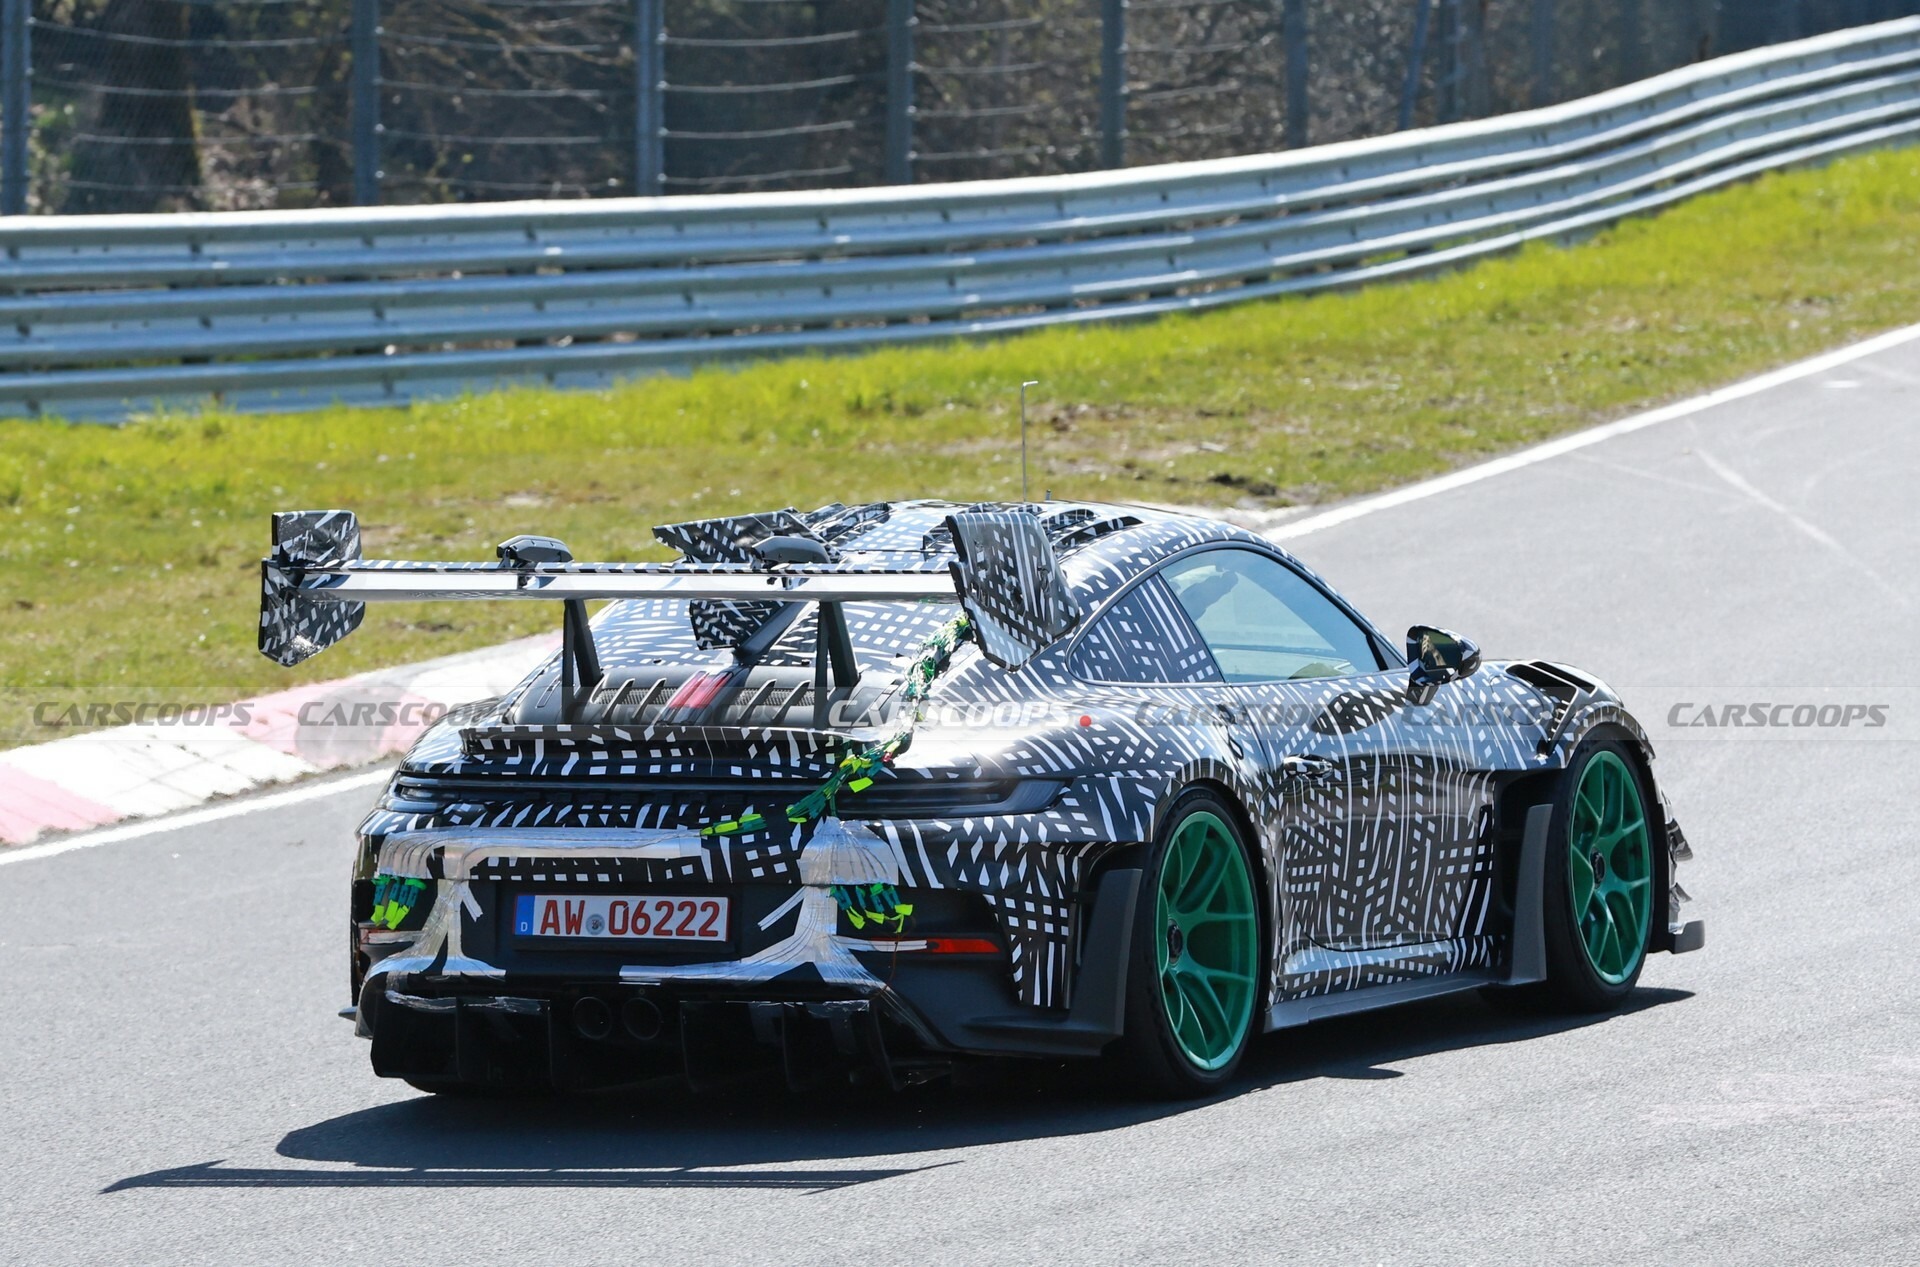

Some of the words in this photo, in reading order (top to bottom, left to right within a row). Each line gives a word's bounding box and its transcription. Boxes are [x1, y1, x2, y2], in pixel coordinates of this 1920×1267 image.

[520, 922, 528, 932] D
[540, 900, 585, 935] AW
[608, 901, 719, 937] 06222
